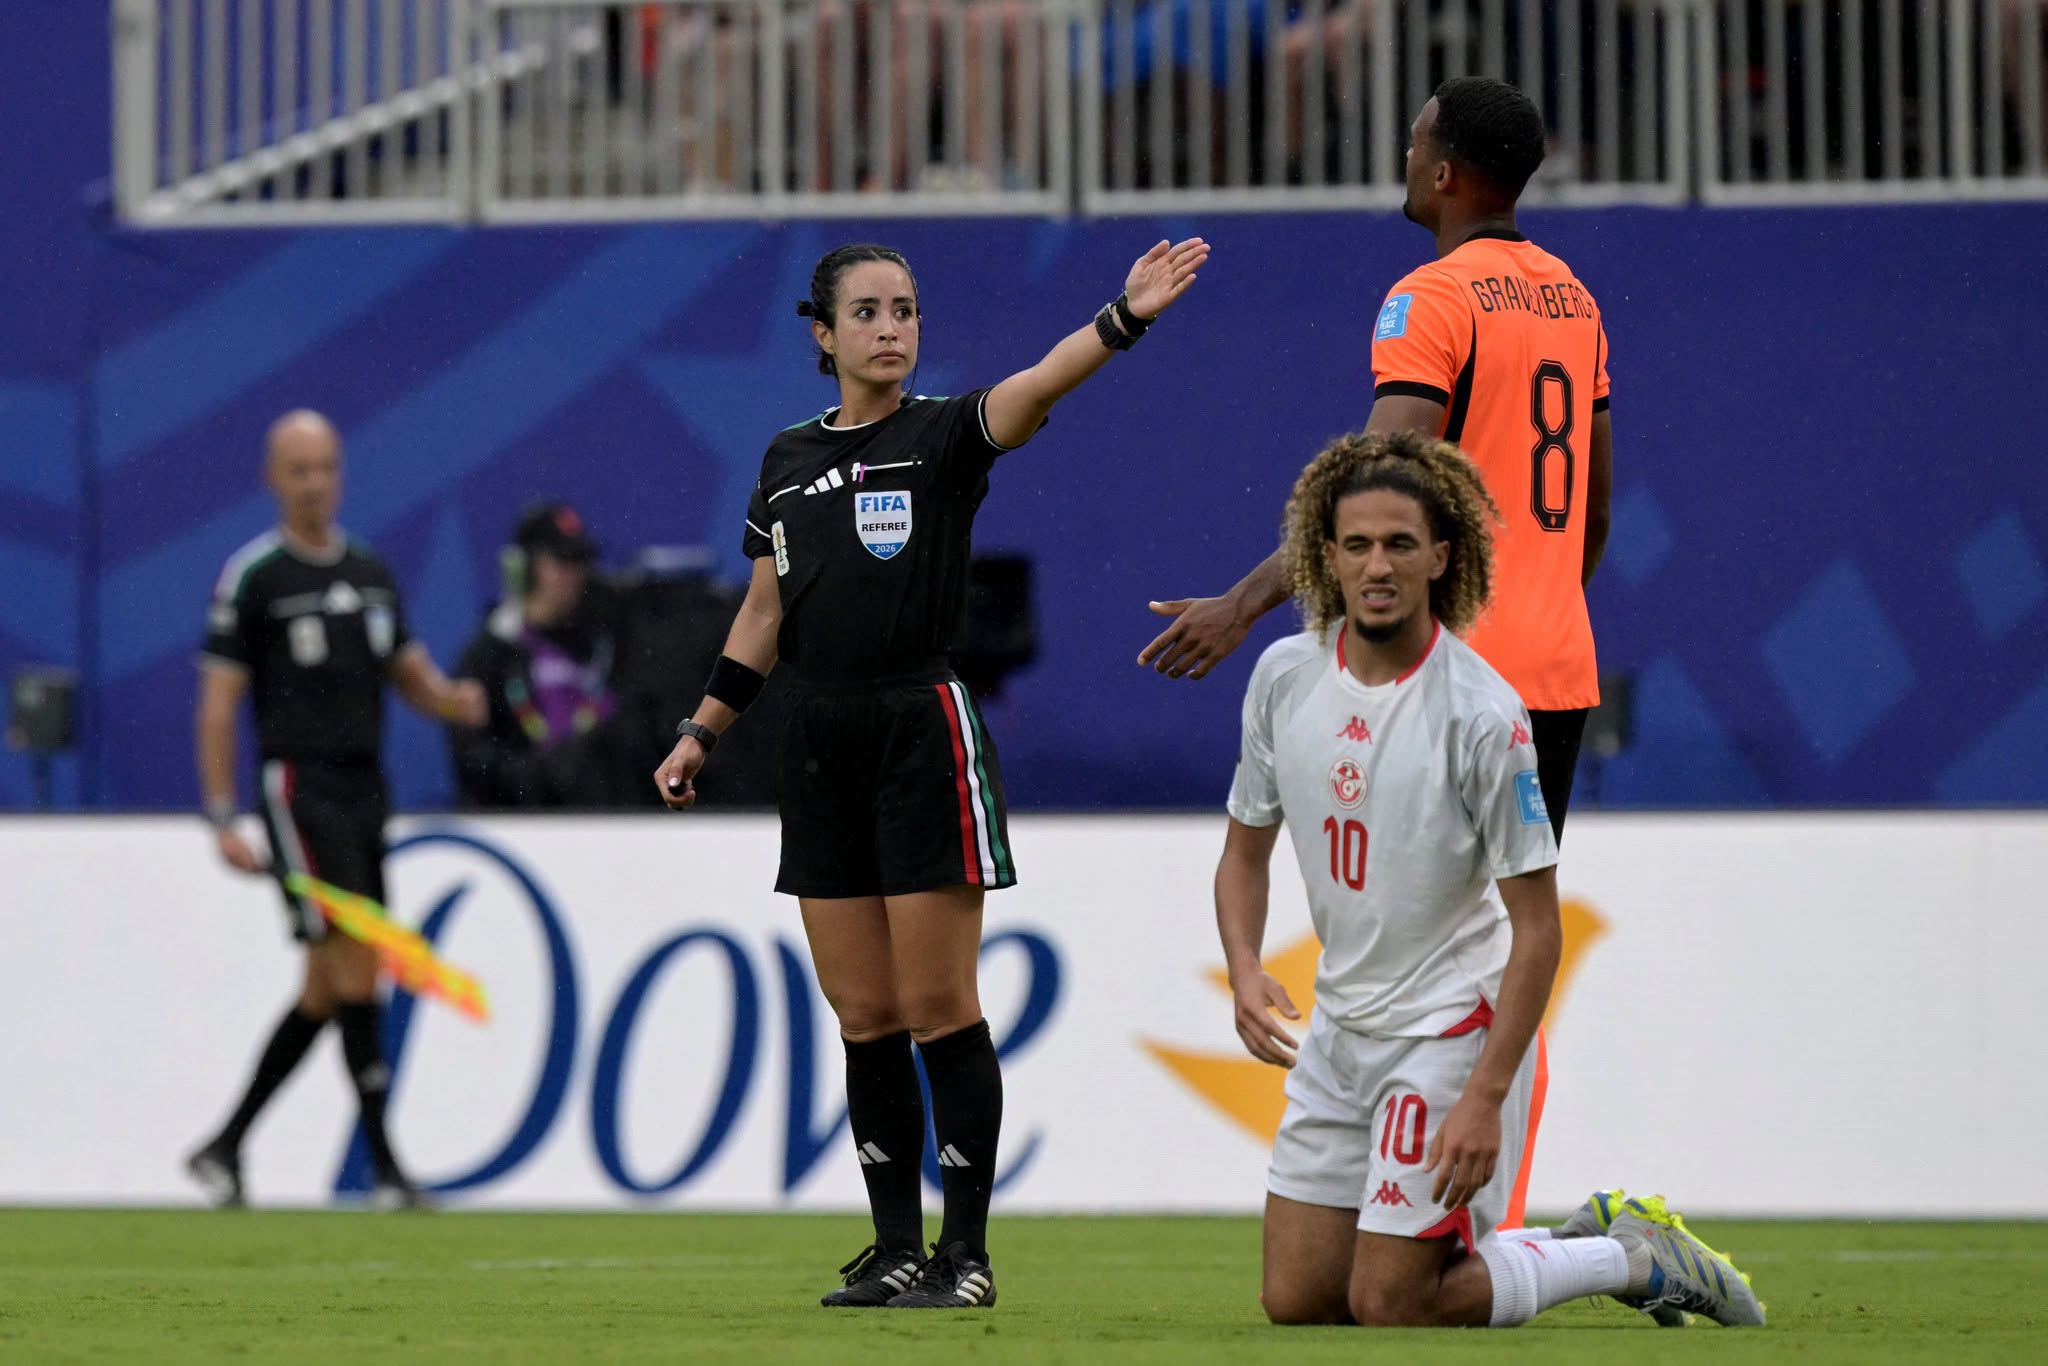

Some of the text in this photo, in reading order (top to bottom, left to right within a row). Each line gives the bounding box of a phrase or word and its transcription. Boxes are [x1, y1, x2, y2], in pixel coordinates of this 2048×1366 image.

[1531, 359, 1574, 532] 8
[860, 495, 906, 513] FIFA
[861, 521, 908, 532] REFEREE
[875, 544, 896, 553] 2026
[1323, 814, 1369, 892] 10
[1380, 1093, 1428, 1165] 10
